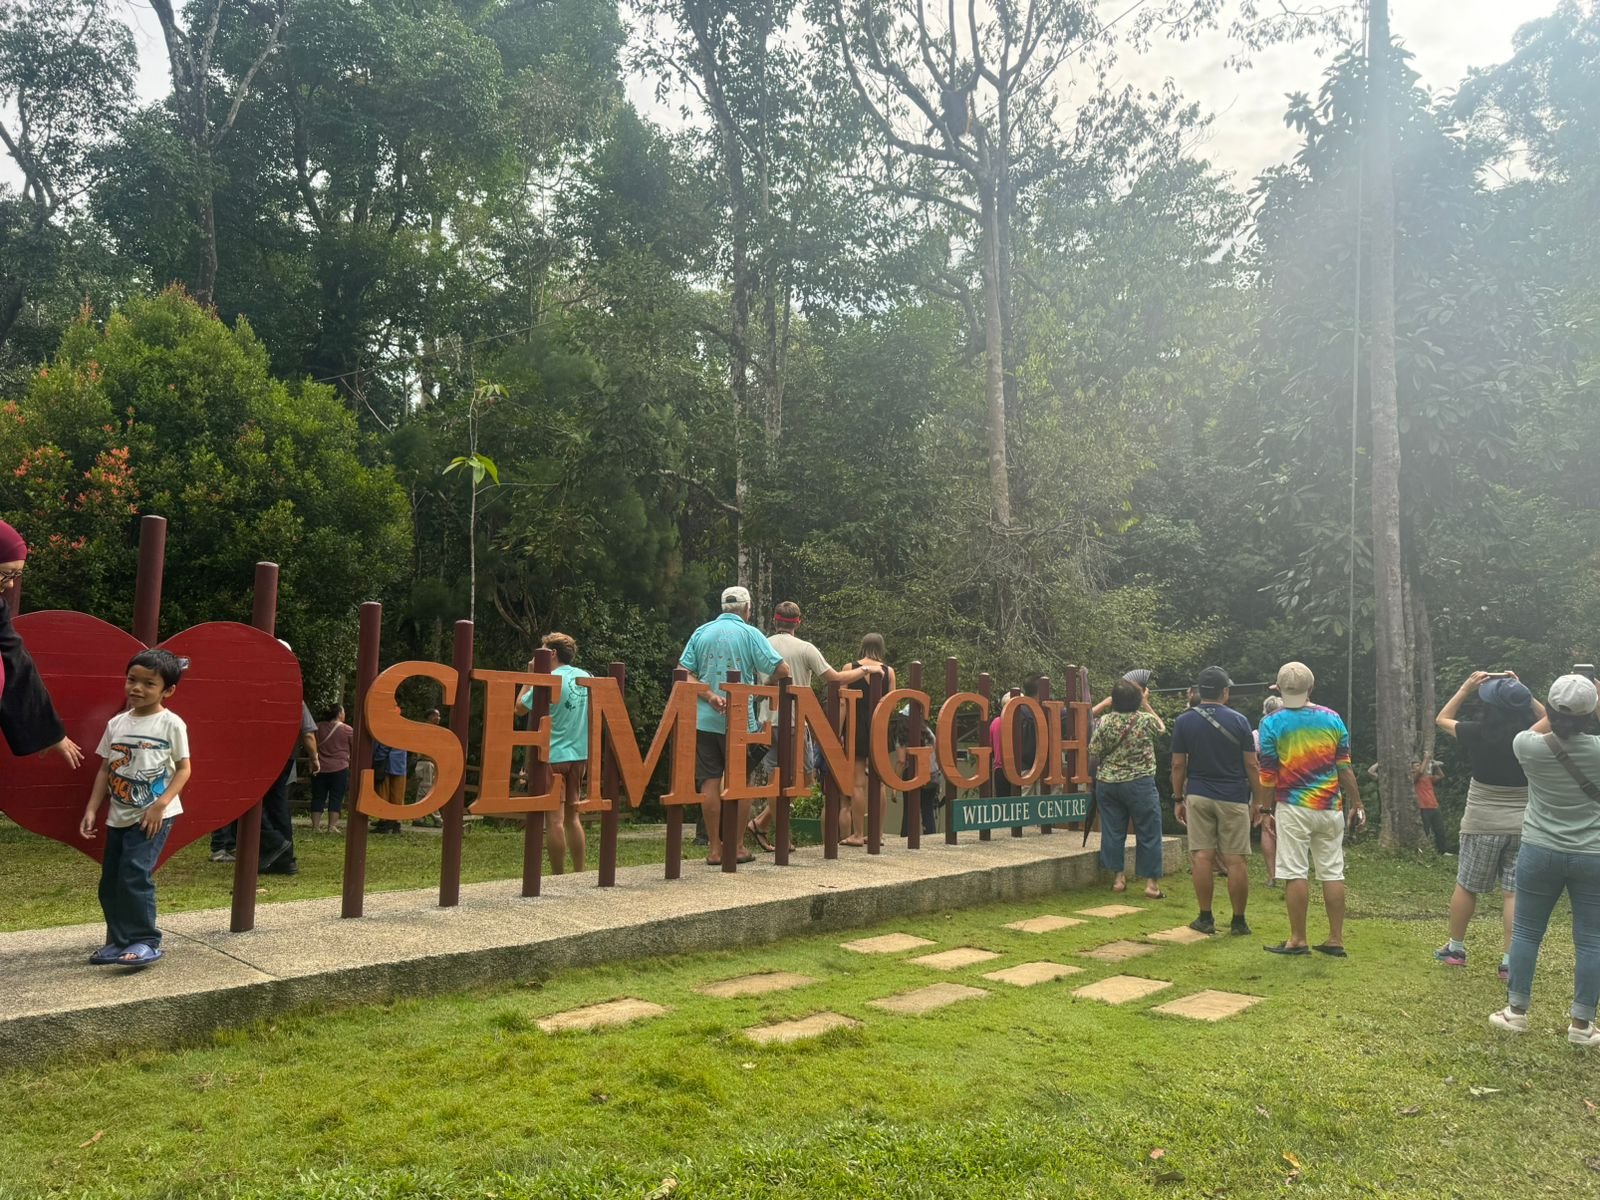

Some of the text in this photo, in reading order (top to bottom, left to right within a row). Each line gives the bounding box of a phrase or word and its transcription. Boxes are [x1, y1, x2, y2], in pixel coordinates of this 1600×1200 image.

[356, 660, 1092, 820] SEMENGGOH
[962, 799, 1087, 824] WILDLIFE CENTRE
